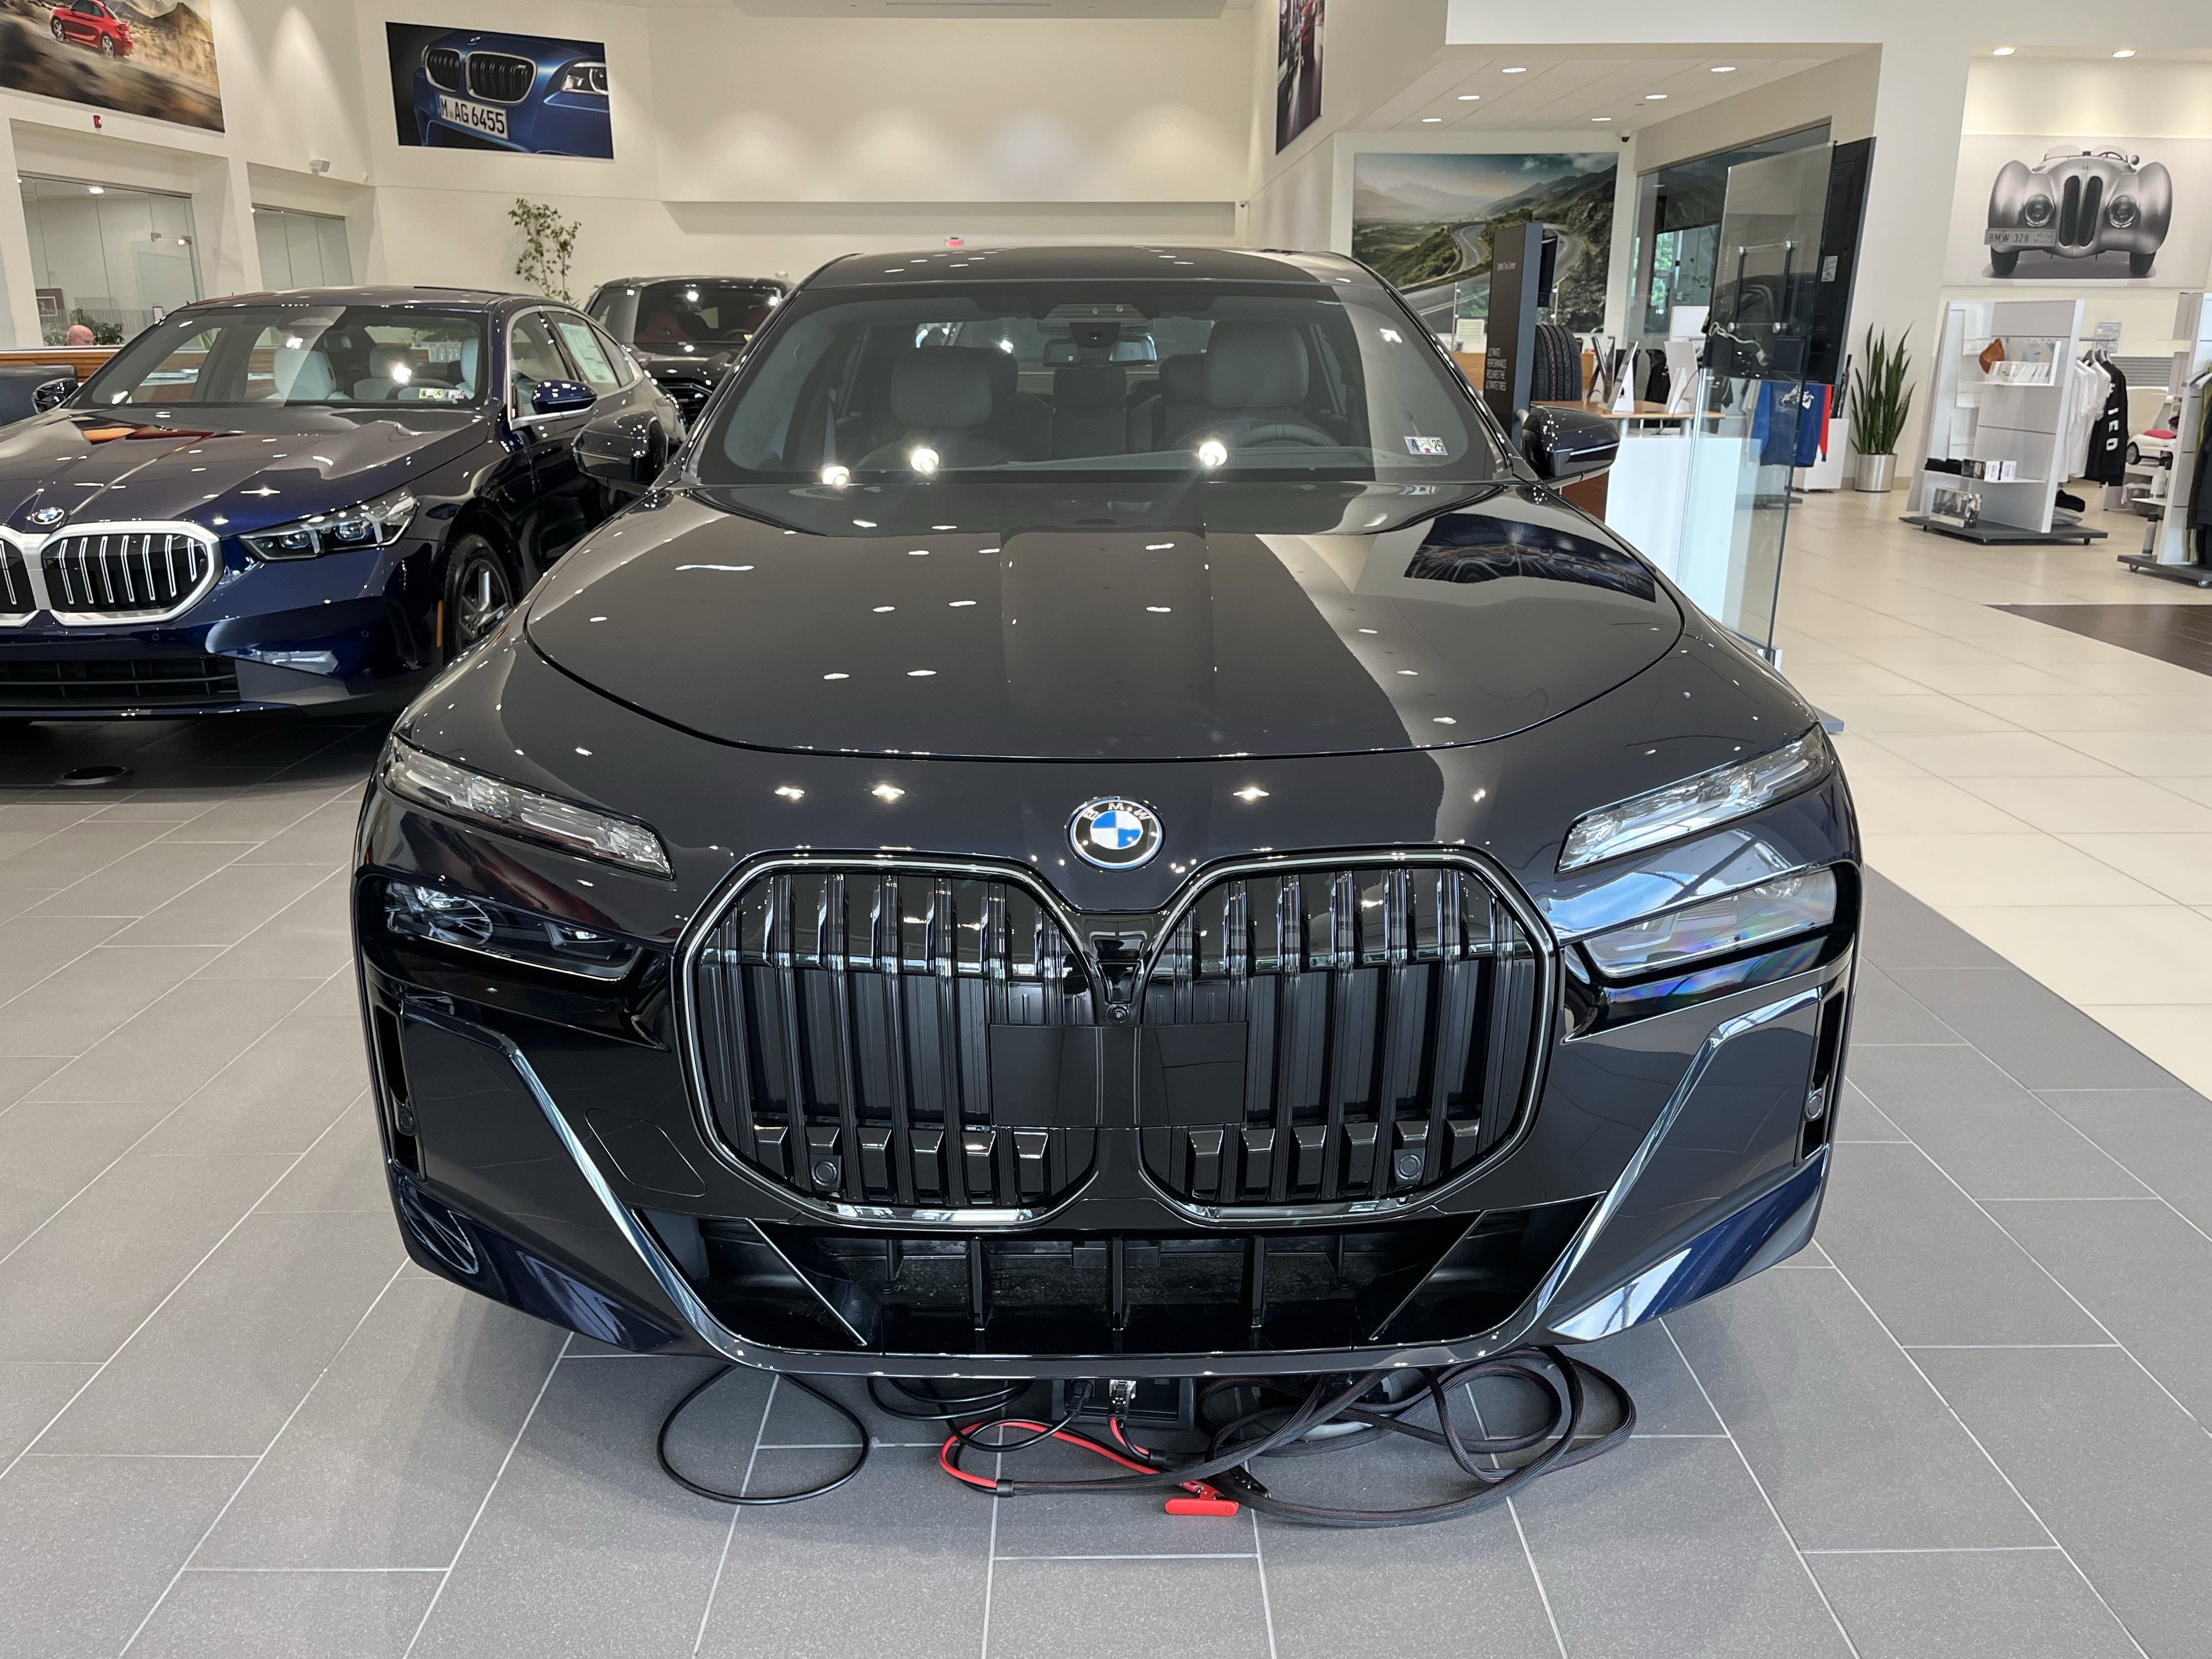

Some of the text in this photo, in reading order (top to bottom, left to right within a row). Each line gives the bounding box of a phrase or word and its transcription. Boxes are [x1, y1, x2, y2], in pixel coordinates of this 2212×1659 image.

[441, 98, 505, 134] M AG 6455
[1989, 233, 2010, 242] BMW
[2014, 233, 2029, 242] 328
